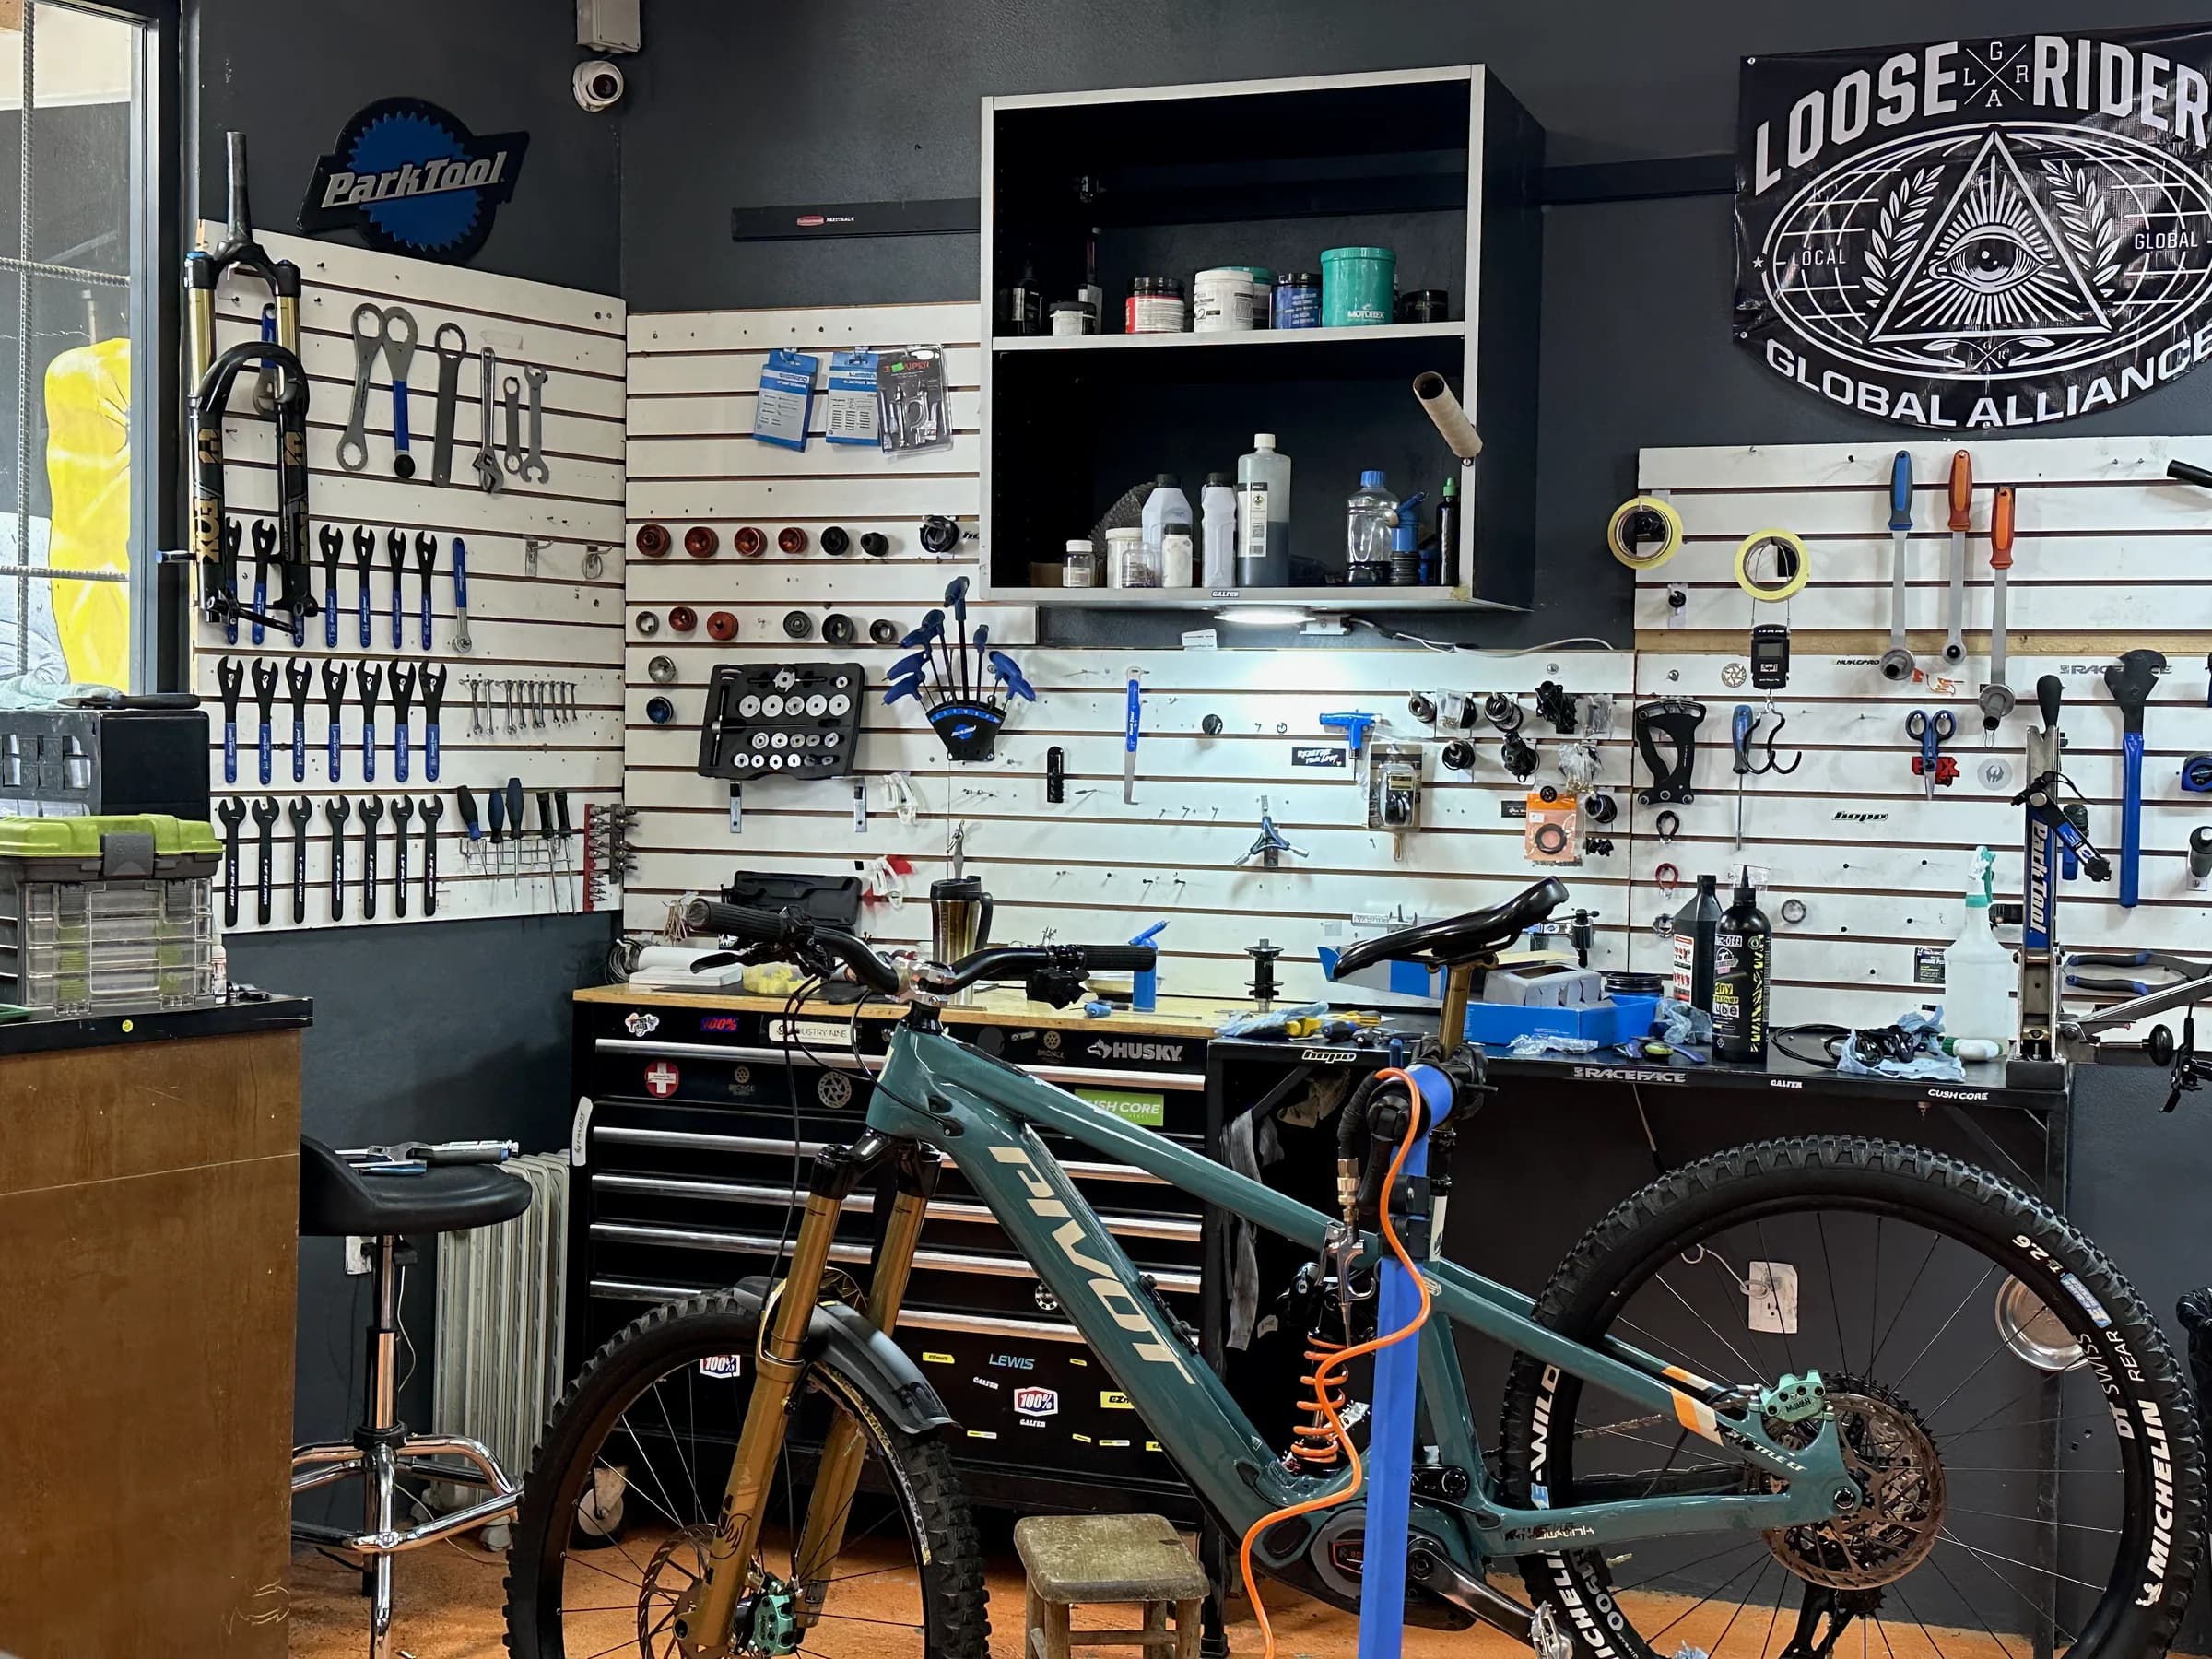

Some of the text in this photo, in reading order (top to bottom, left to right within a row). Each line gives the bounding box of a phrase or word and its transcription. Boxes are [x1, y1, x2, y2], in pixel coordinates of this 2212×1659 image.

[1755, 41, 1958, 196] LOOSE
[2135, 231, 2198, 250] GLOBAL
[1791, 248, 1847, 267] LOCAL
[1766, 338, 1957, 427] GLOBAL
[1112, 1041, 1183, 1062] HUSKY
[1959, 1091, 1988, 1100] CORE
[1119, 1102, 1160, 1114] CORE
[2012, 1234, 2050, 1261] 2.6
[988, 1146, 1196, 1385] PIVOT
[705, 1356, 735, 1371] 100%
[989, 1353, 1035, 1370] LEWIS
[2077, 1333, 2120, 1395] SWISS
[2106, 1330, 2146, 1382] REAR
[1019, 1393, 1053, 1410] 100%
[2109, 1402, 2136, 1440] DT
[2138, 1400, 2174, 1579] MICHELIN
